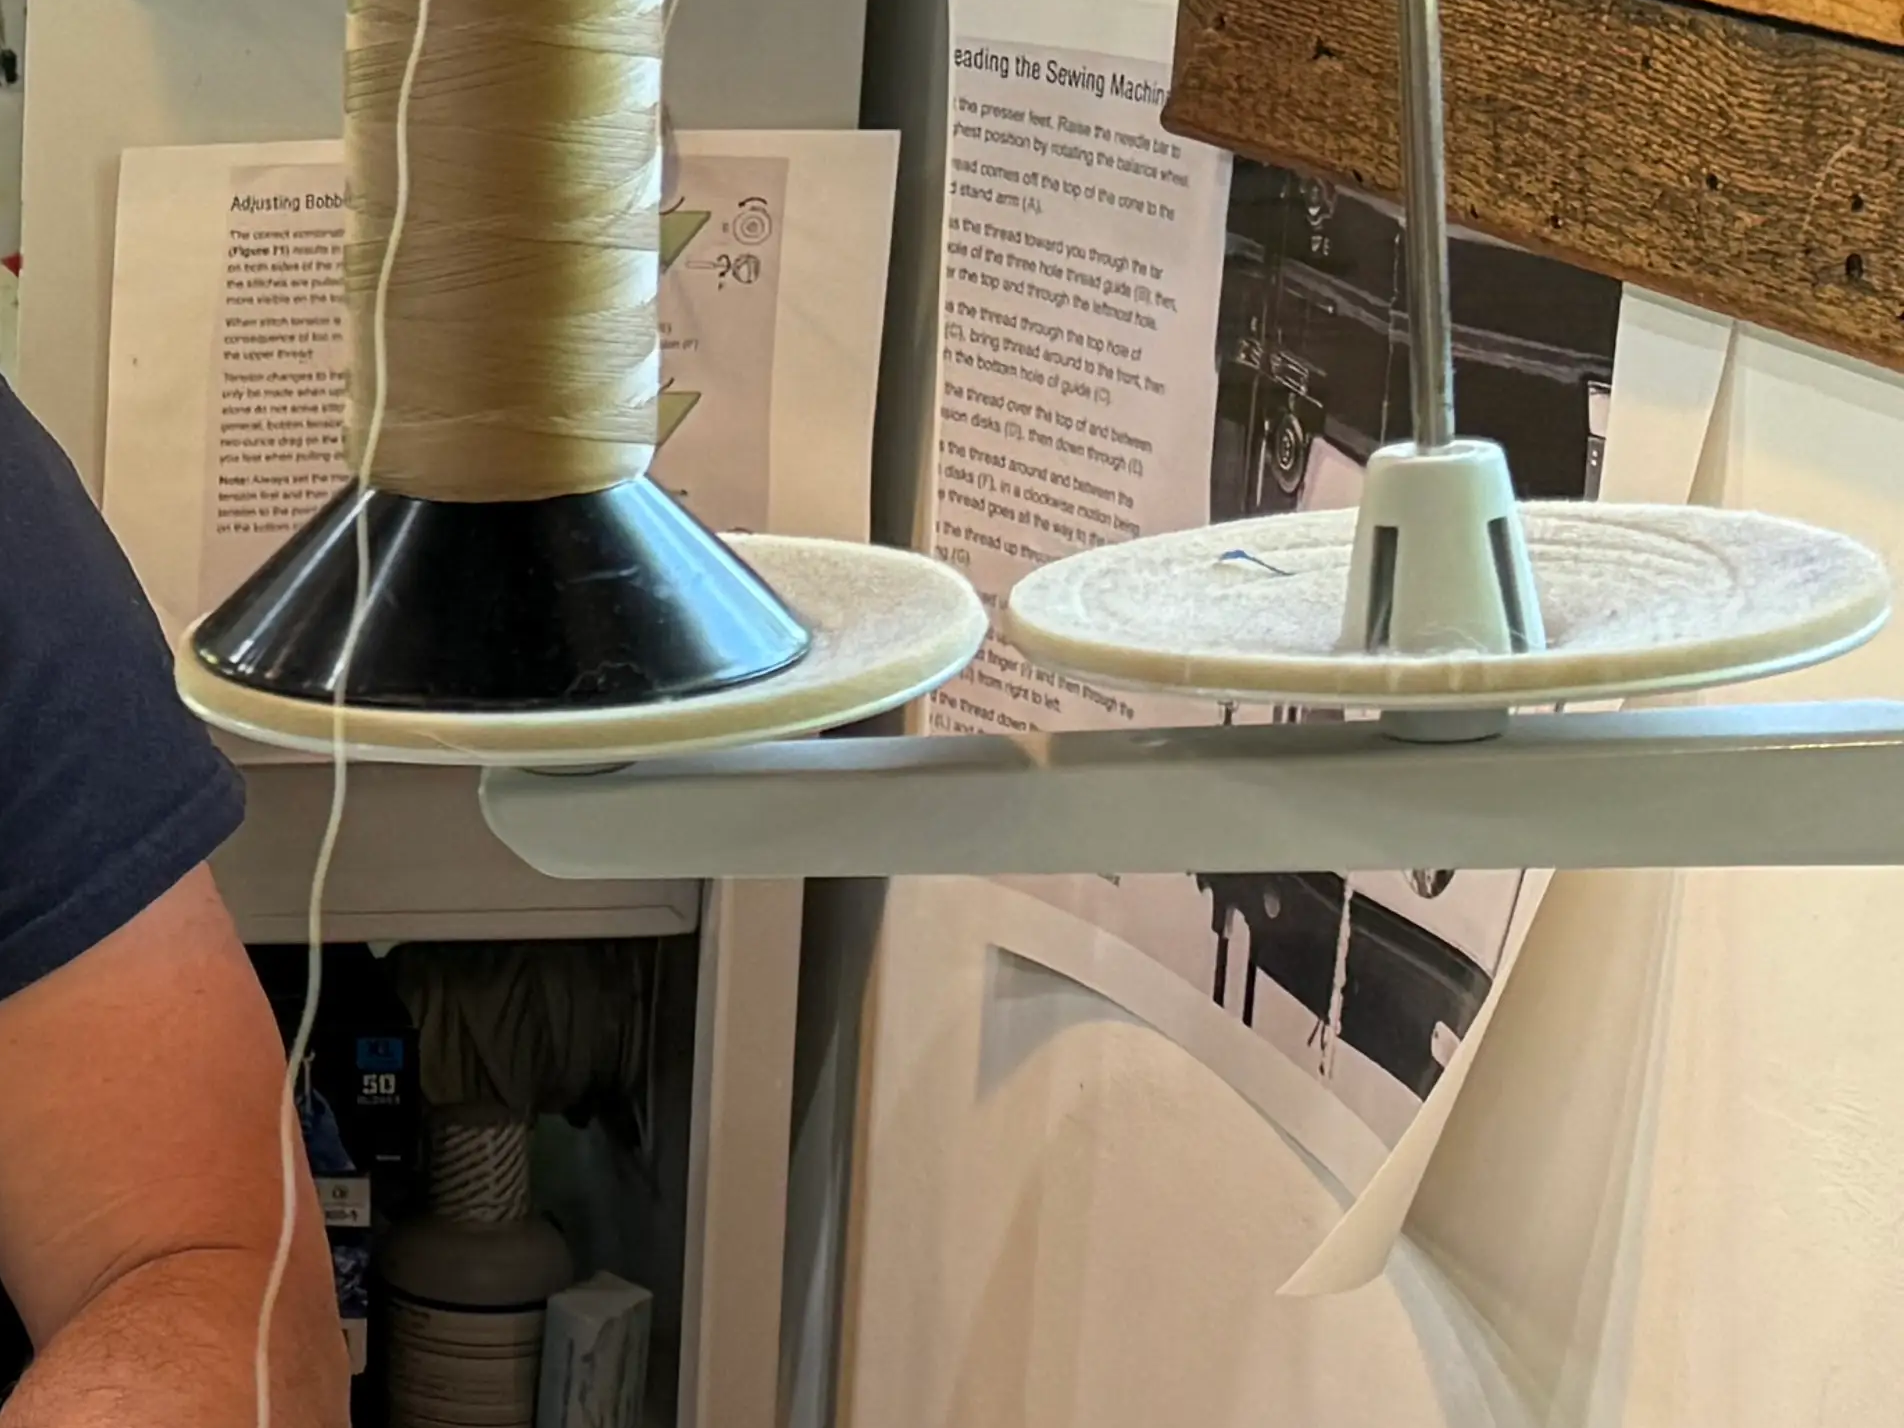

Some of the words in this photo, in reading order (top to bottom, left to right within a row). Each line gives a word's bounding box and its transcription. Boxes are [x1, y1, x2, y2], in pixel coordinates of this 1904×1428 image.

[954, 48, 1009, 78] eading
[1015, 54, 1042, 80] the
[1046, 60, 1105, 97] Sewing
[230, 194, 300, 213] Adjusting
[305, 192, 348, 209] Bobb
[362, 1073, 396, 1095] 50
